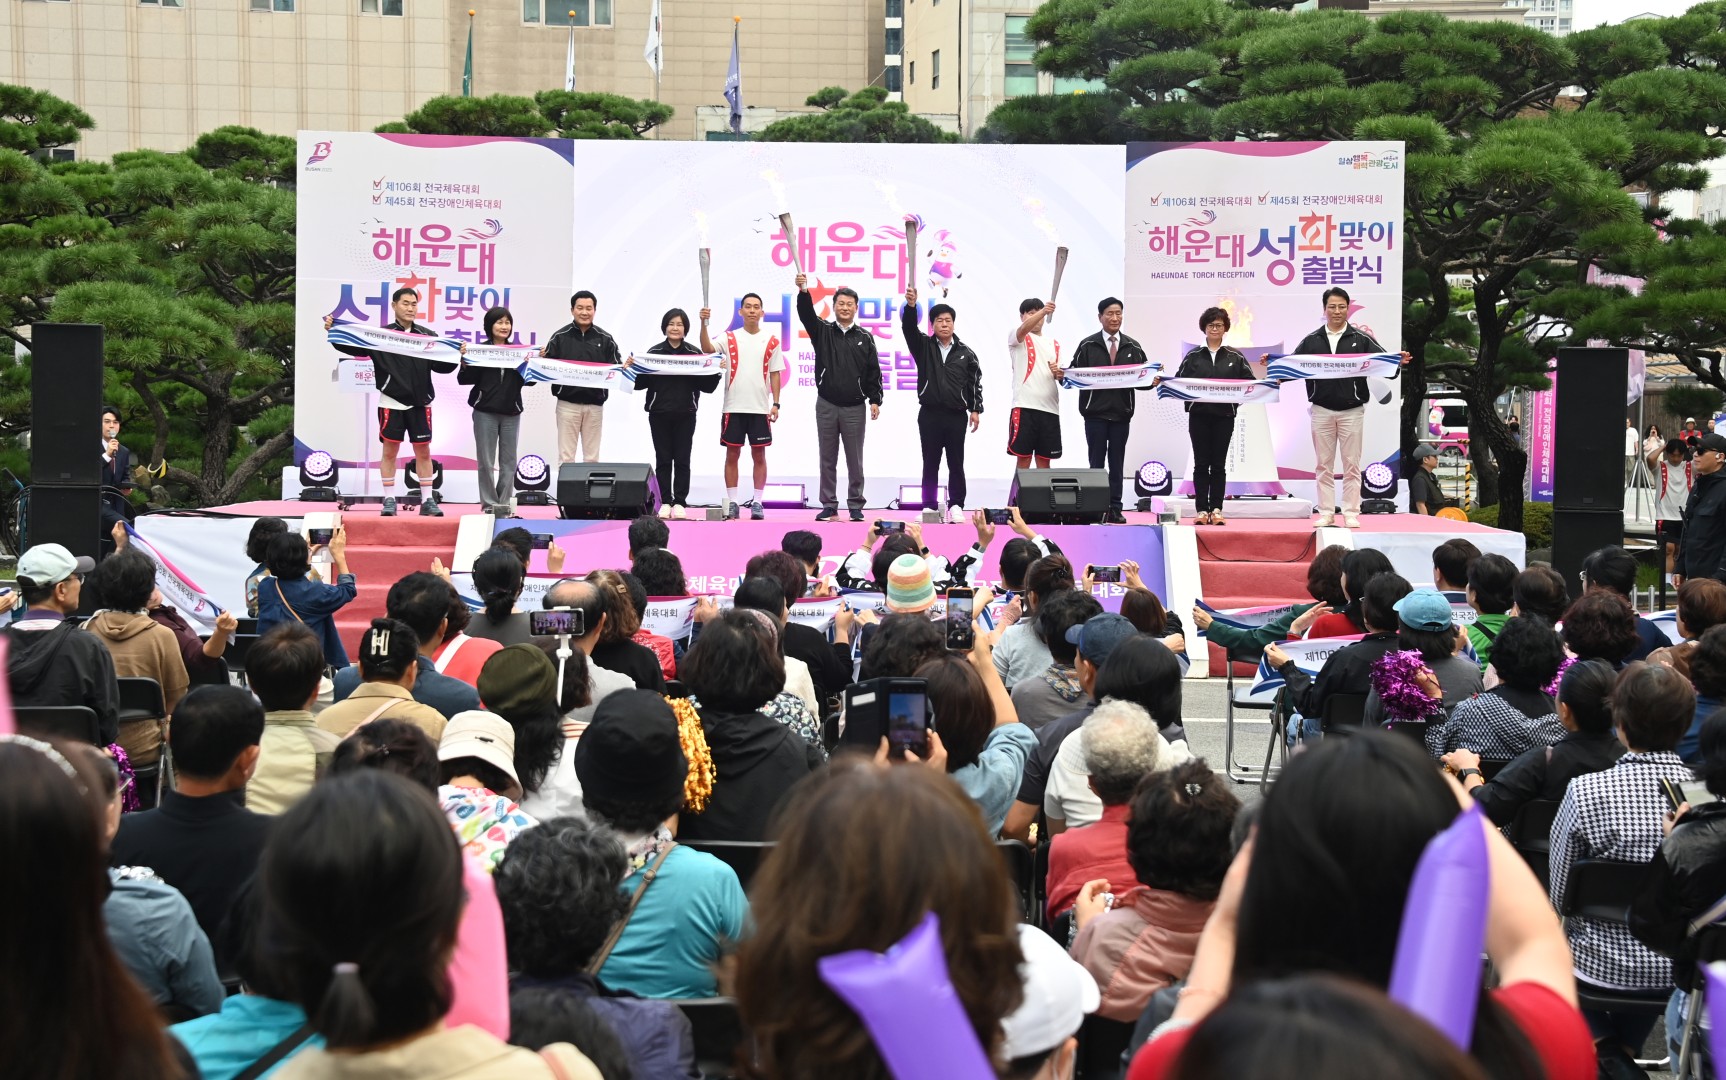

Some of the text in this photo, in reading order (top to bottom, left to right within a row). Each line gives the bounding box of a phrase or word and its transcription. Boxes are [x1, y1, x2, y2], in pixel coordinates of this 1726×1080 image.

[385, 181, 480, 194] 제106회 전국체육대회
[385, 195, 502, 210] 제45회 전국장애인체육대회
[1162, 196, 1252, 207] 제106회 전국체육대회
[1270, 194, 1383, 205] 제45회 전국장애인체육대회
[372, 224, 496, 285] 해운대
[1149, 209, 1394, 286] 해운대 성화맞이
[1151, 271, 1188, 279] HAEUNDAE
[1302, 255, 1382, 285] 출발식
[388, 336, 422, 346] 전국체육대회
[1541, 407, 1551, 484] 전국장애인체육대회
[168, 572, 195, 603] 전국체육대회
